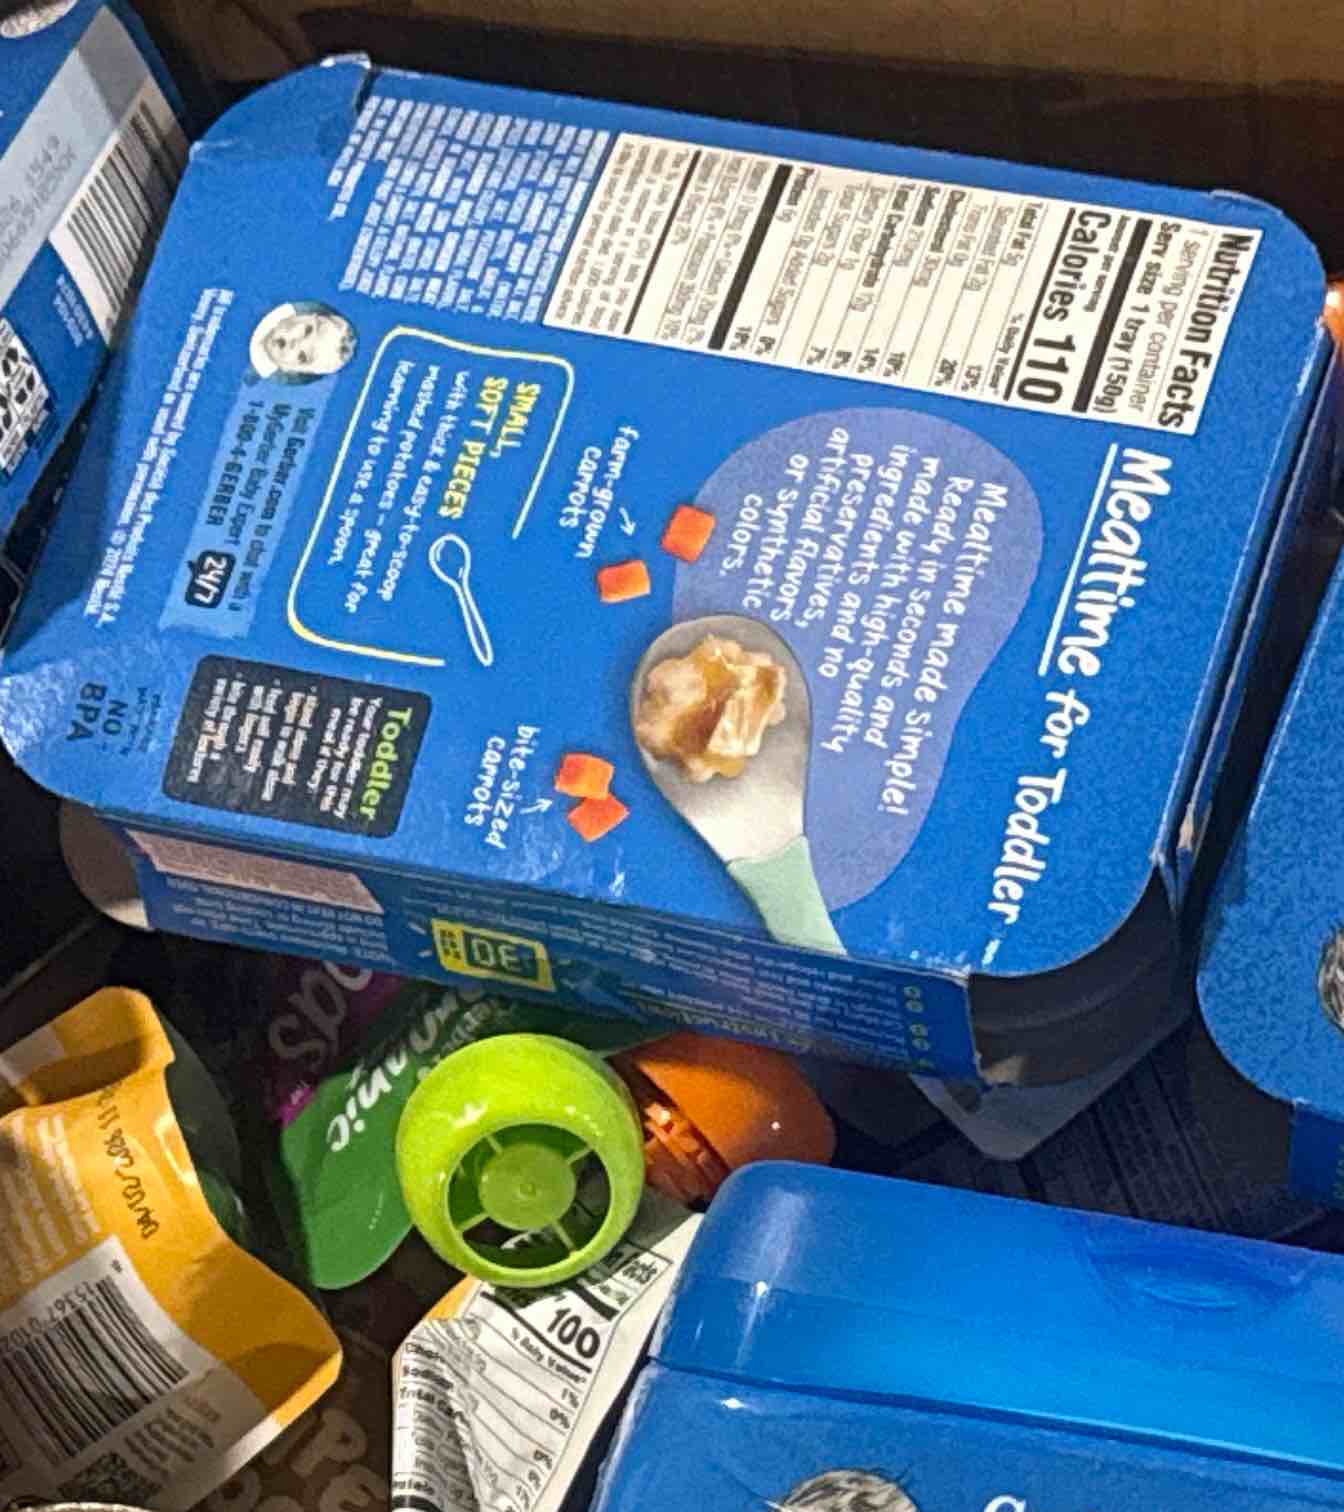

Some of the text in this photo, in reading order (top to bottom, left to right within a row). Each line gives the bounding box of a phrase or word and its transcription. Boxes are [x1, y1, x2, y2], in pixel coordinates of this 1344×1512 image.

[1016, 207, 1111, 404] Calories 110
[1092, 220, 1182, 413] Serv size tray (150g)
[1156, 232, 1254, 428] Nutrition Facts
[437, 376, 509, 519] SOFT PIECES
[558, 446, 602, 528] carrots
[575, 425, 639, 558] farm-grown
[768, 426, 849, 621] artificial flavors
[718, 493, 763, 576] colors.
[741, 453, 809, 608] or synthetic
[793, 446, 874, 628] preservatives,
[817, 444, 909, 678] ingredients and no
[819, 457, 940, 753] made with high-quality
[862, 476, 974, 748] Ready in seconds and
[881, 482, 1007, 815] Mealtime made simple!
[987, 447, 1171, 924] Mealtime for Toddler
[66, 681, 107, 743] BPA
[101, 699, 128, 736] NO
[358, 707, 412, 820] Toddler
[463, 735, 505, 826] carrots
[484, 724, 539, 849] bite-sized
[546, 1307, 600, 1359] 100
